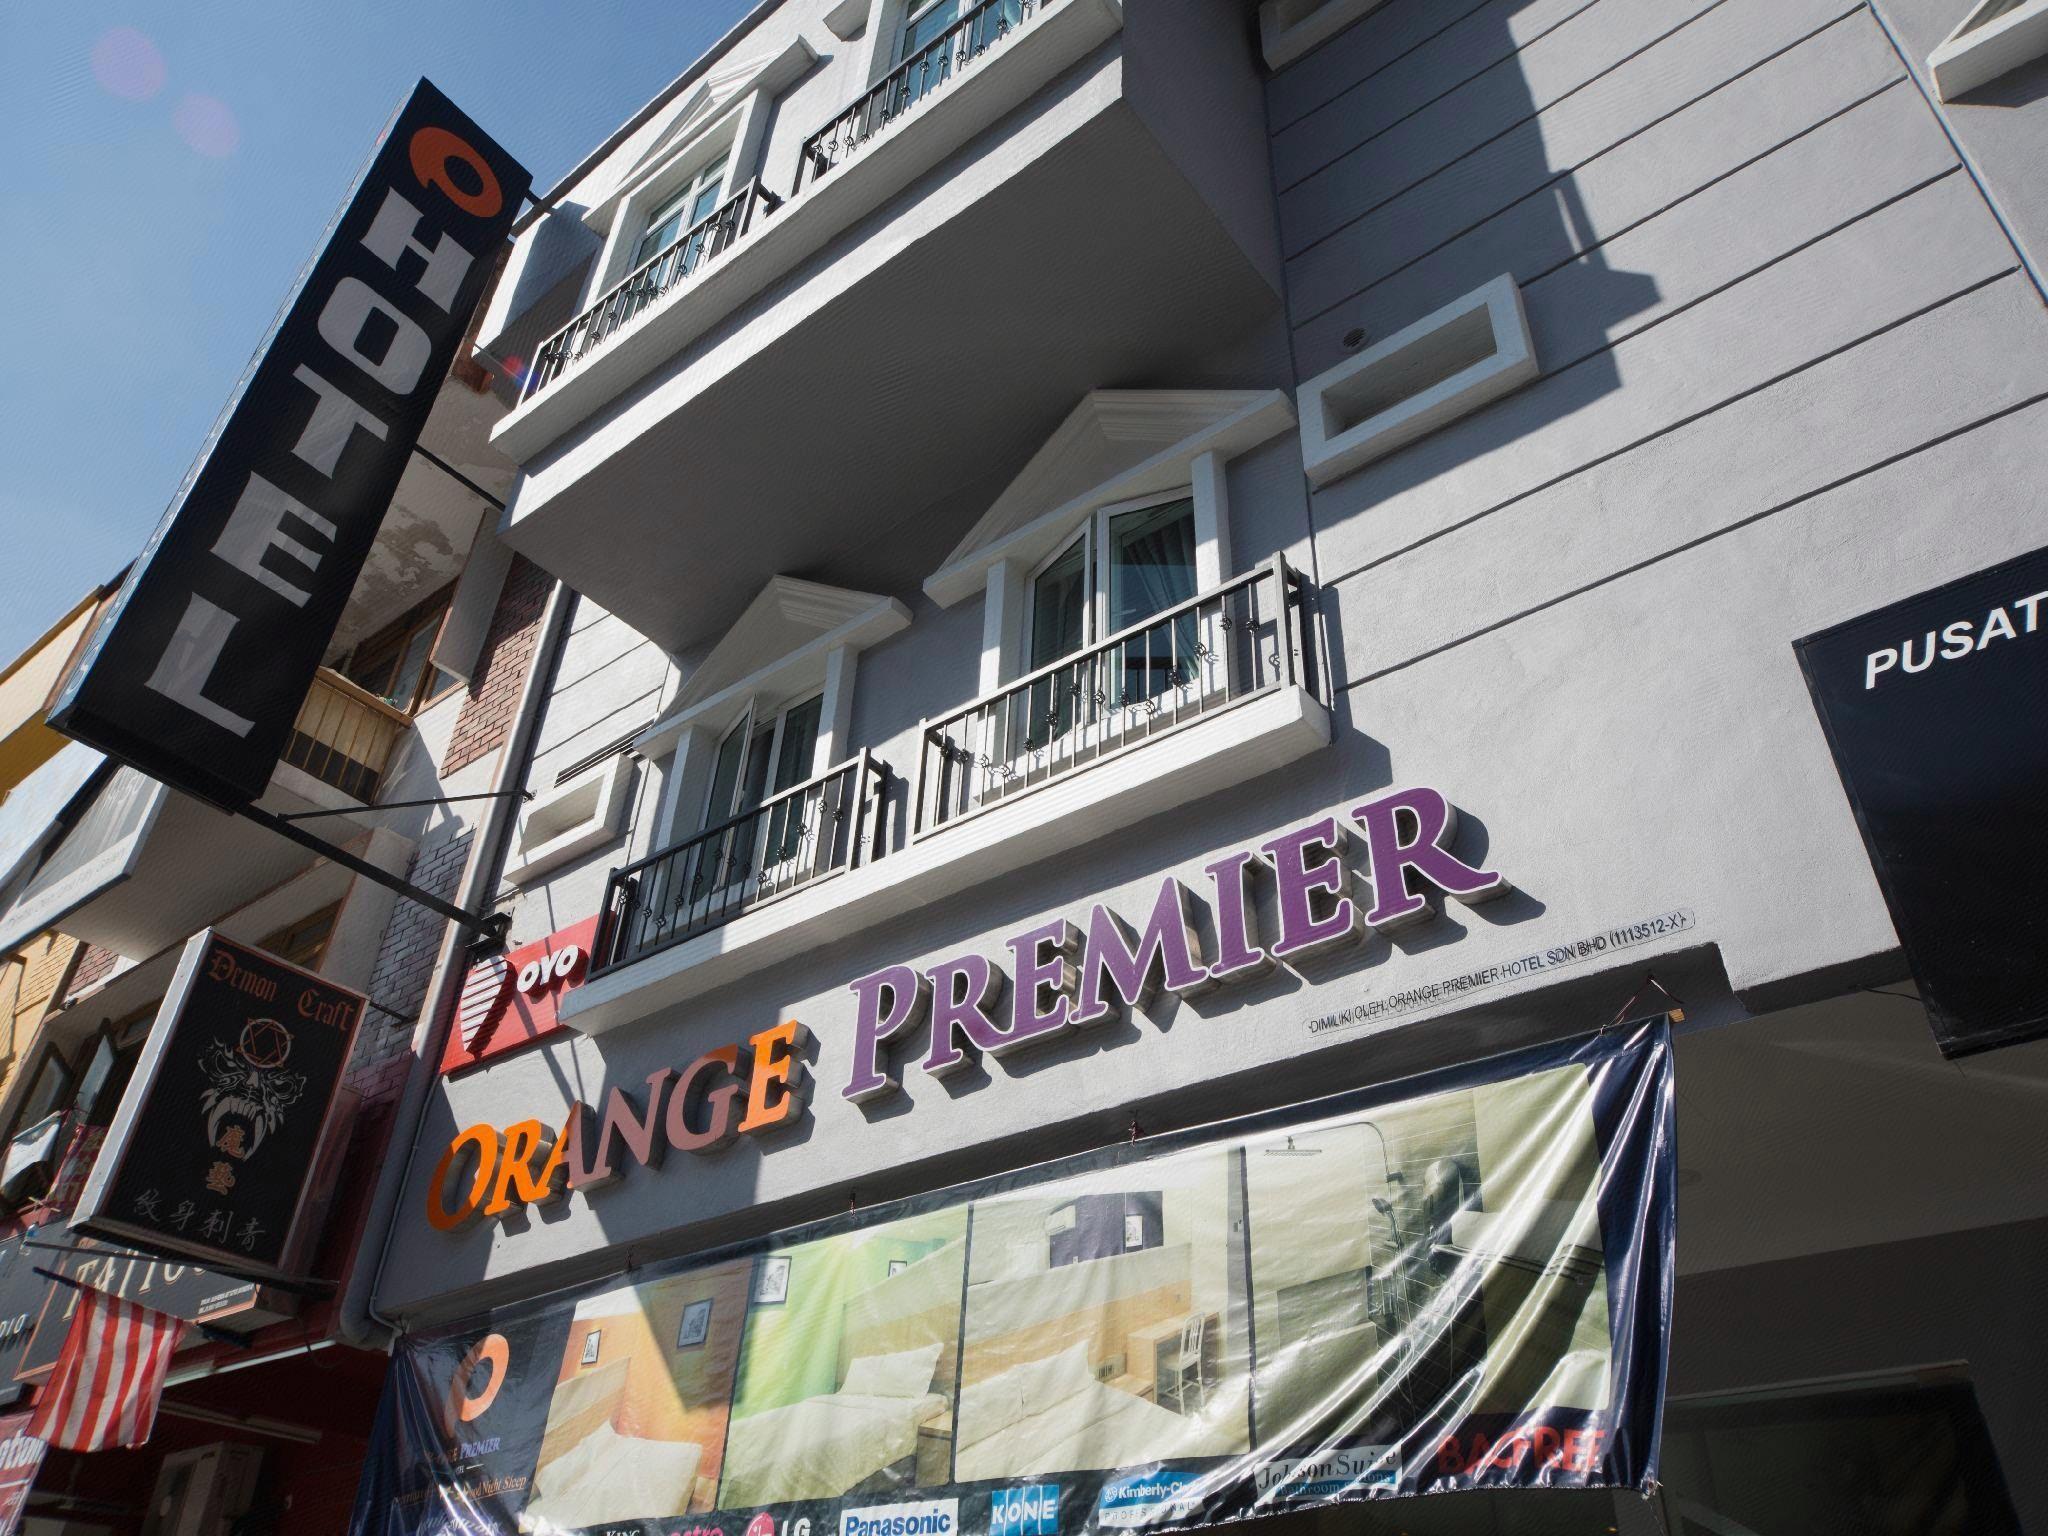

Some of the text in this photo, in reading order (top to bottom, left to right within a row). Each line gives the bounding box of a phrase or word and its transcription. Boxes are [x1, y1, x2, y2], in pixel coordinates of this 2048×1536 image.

[144, 186, 475, 738] HOTEL
[1864, 590, 2048, 690] PUSAT
[208, 950, 355, 1032] Demon Craft
[516, 944, 580, 993] OYO
[1388, 984, 1439, 1008] ORANGE
[1442, 967, 1500, 992] PREMIER
[1502, 955, 1546, 978] HOTEL
[1547, 944, 1577, 965] SDN
[1577, 935, 1607, 956] BHD
[426, 786, 1503, 1232] ORANGE PREMIER
[460, 1436, 501, 1460] PREMIER
[502, 1472, 527, 1490] Sleep
[844, 1508, 951, 1536] Panasonic
[991, 1499, 1057, 1525] KONE
